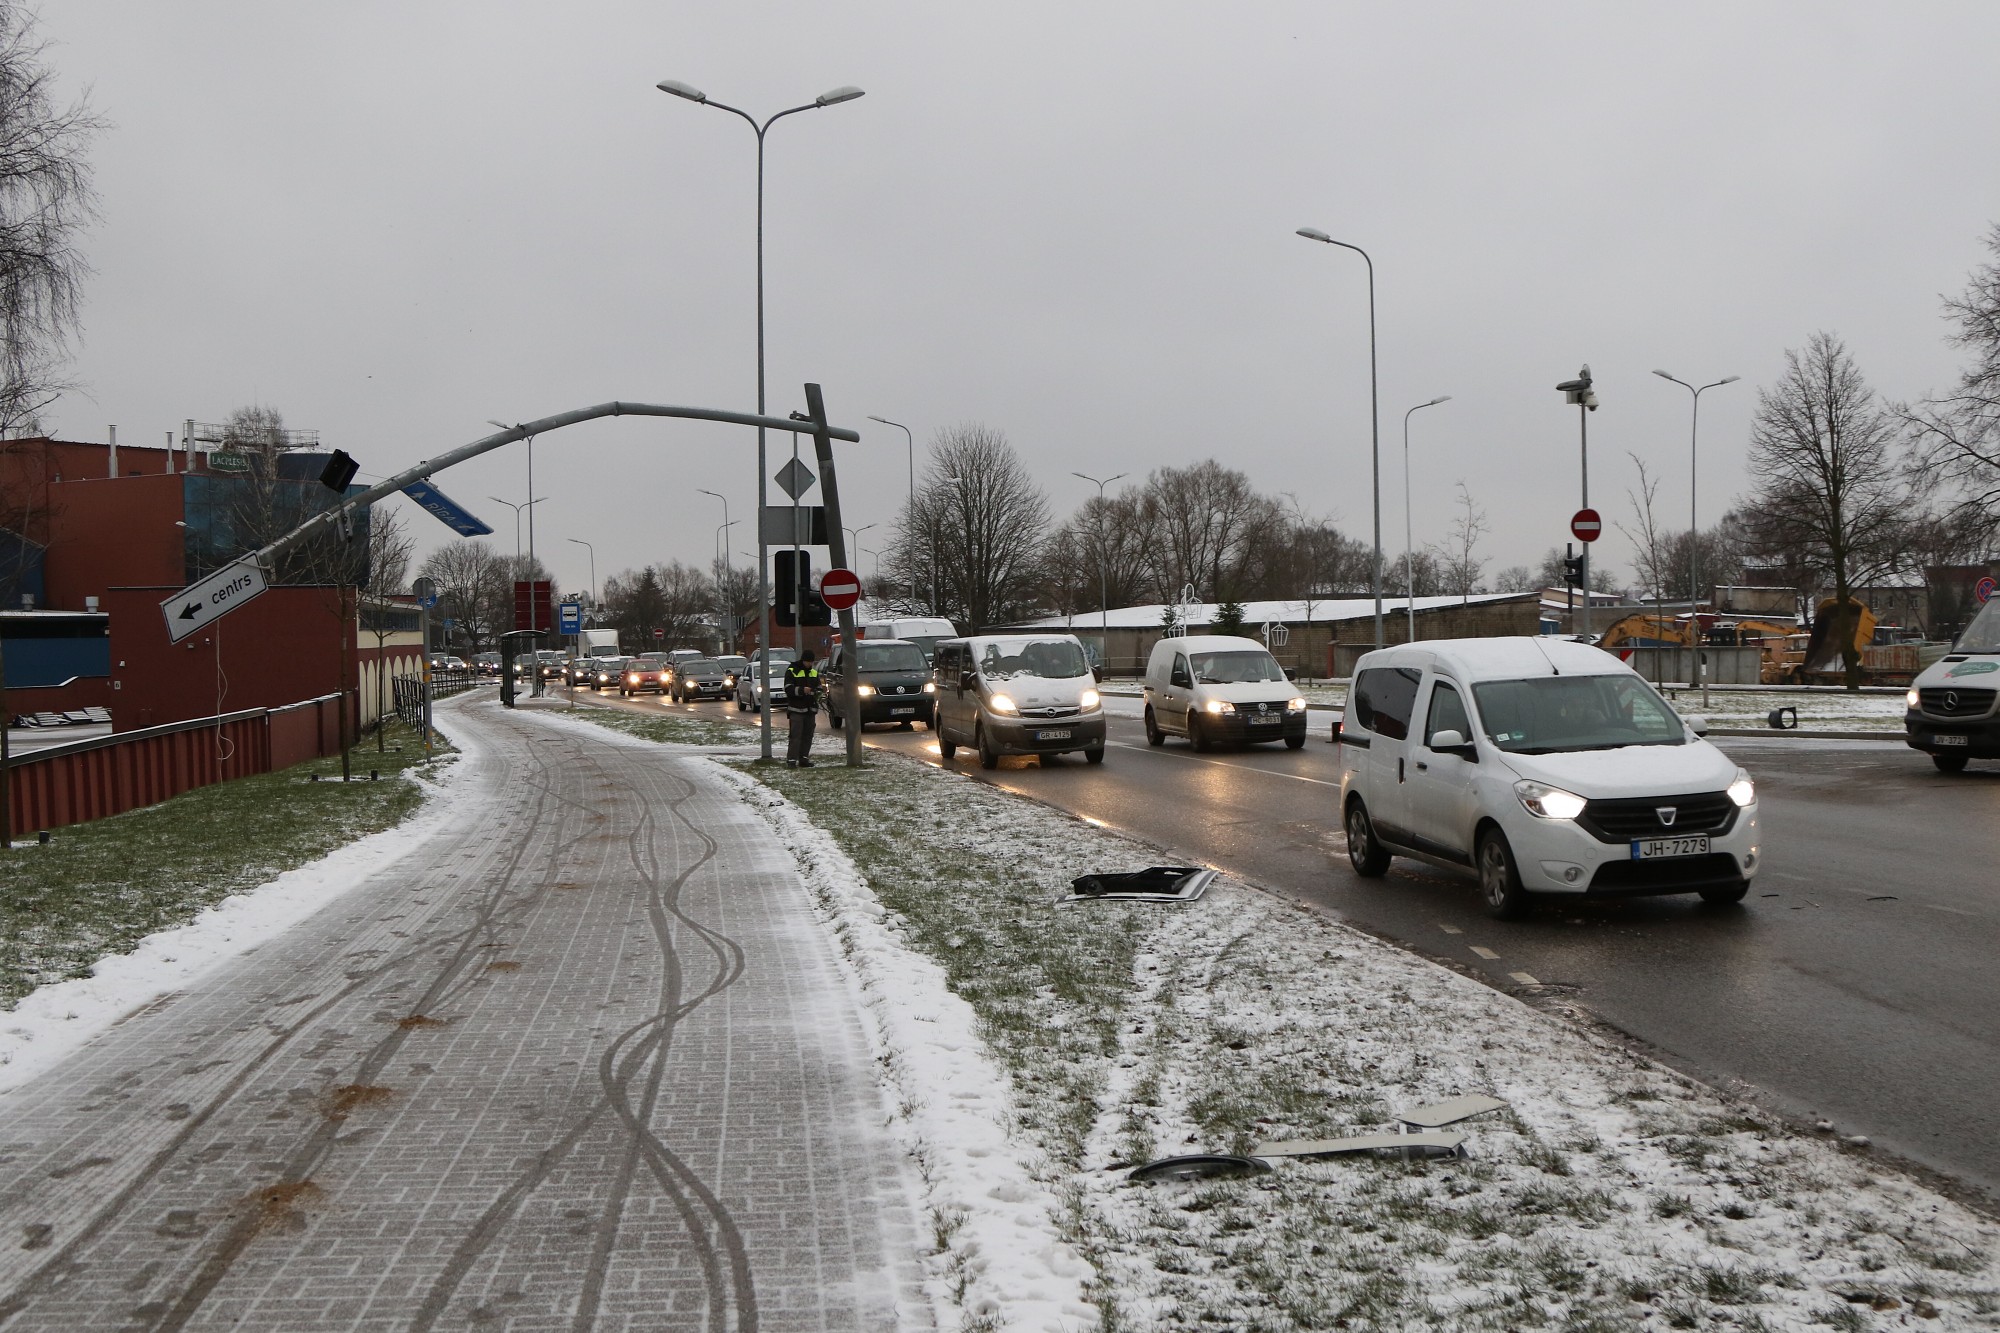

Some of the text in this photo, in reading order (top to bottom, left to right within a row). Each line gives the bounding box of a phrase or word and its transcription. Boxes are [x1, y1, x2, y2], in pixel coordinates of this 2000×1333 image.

[211, 574, 252, 604] centrs
[1040, 731, 1070, 739] GR-4125
[1935, 735, 1966, 744] JV-3723
[1643, 838, 1707, 856] JH-7279
